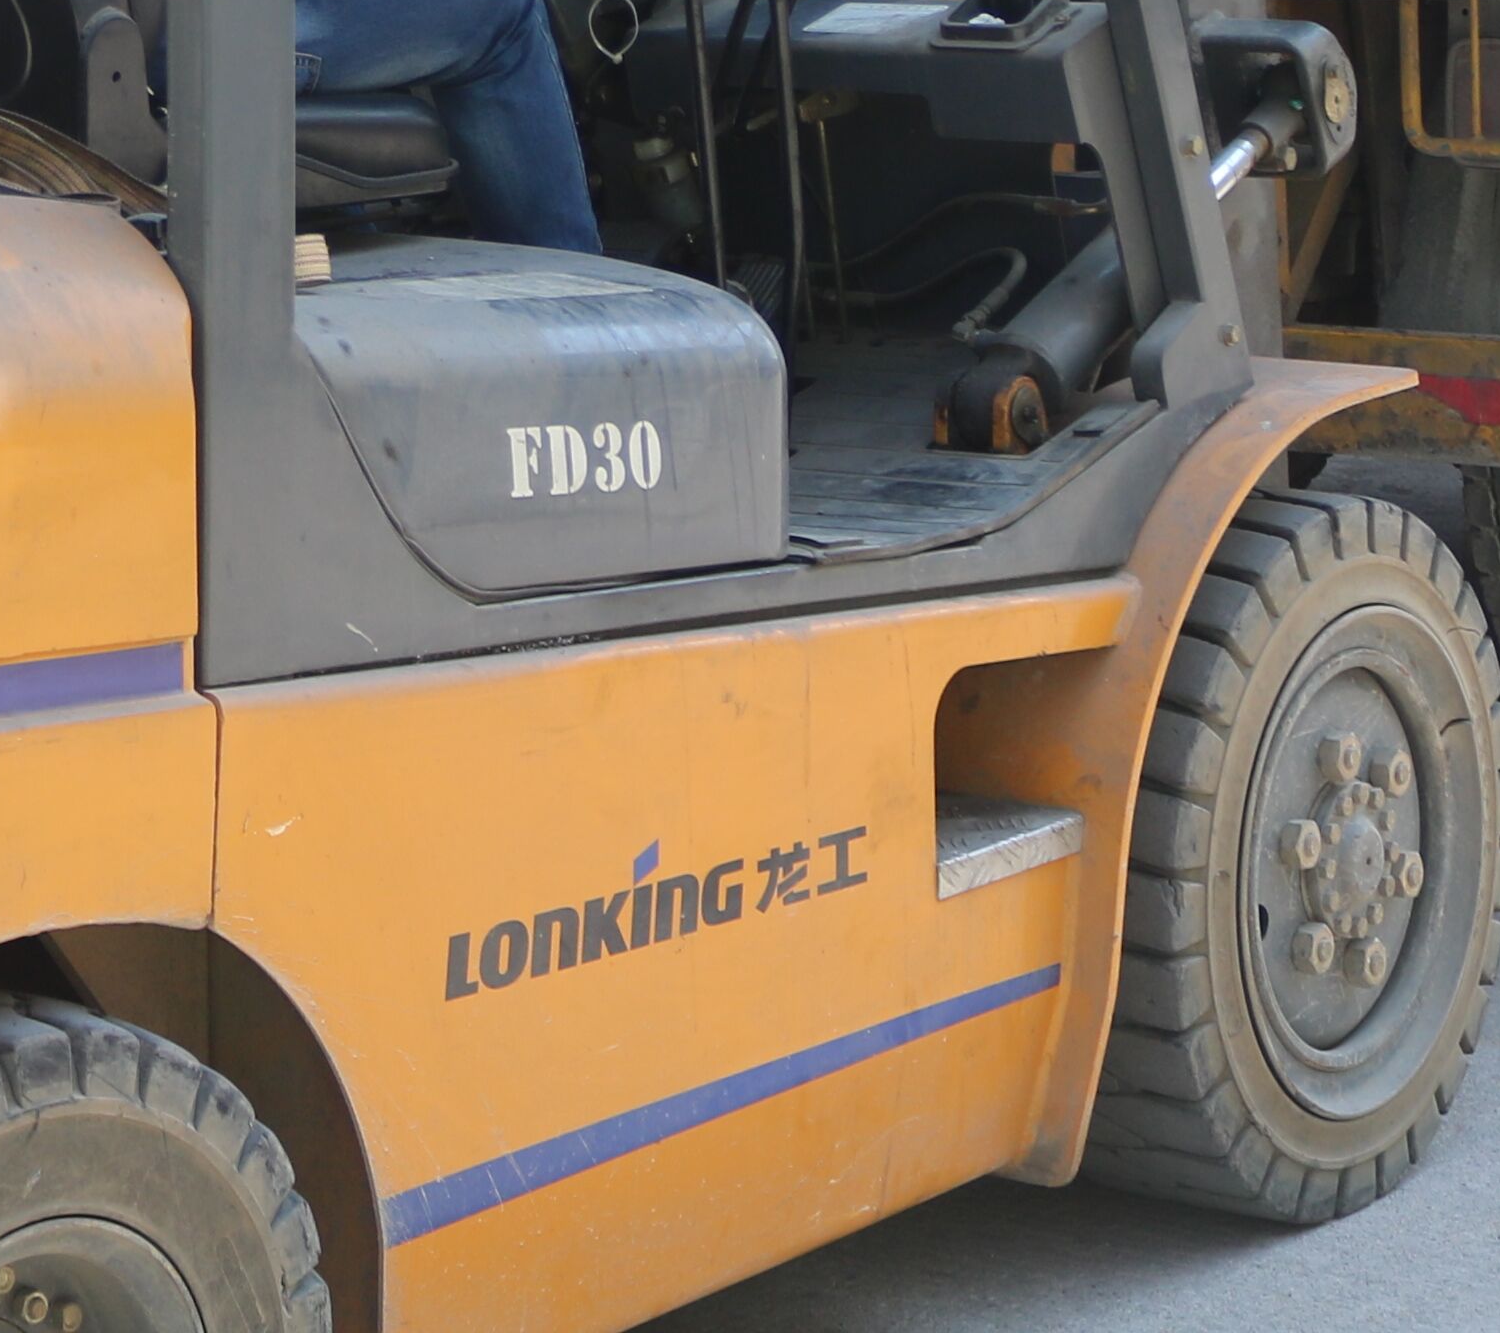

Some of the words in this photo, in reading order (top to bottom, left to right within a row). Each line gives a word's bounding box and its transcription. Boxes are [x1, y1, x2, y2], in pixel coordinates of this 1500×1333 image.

[505, 419, 663, 499] FD30
[443, 838, 744, 1002] LONKING
[756, 825, 869, 915] 龙工
